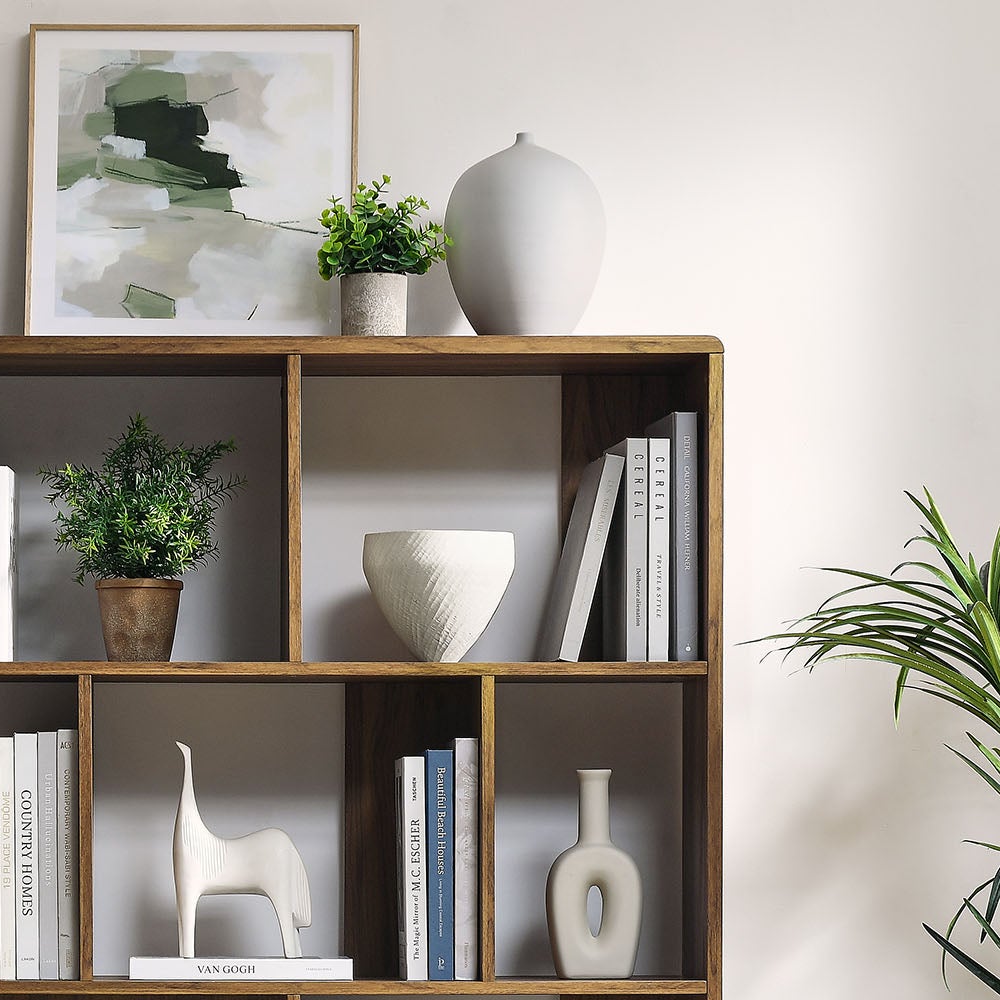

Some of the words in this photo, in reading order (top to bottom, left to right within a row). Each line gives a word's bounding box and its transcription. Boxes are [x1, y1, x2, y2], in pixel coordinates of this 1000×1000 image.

[634, 454, 643, 519] CEREAL
[655, 457, 664, 521] CEREAL
[45, 774, 53, 804] Urban
[437, 767, 446, 809] Beautiful
[21, 790, 32, 859] COUNTRY
[437, 811, 446, 838] Beach
[45, 808, 53, 887] Hallucinations
[410, 819, 420, 863] ESCHER
[3, 844, 11, 874] PLACE
[437, 841, 446, 875] Houses
[3, 878, 11, 888] 19
[22, 864, 33, 916] HOMES
[411, 867, 421, 891] M.C.
[412, 894, 418, 902] of
[413, 927, 421, 946] Magic
[197, 965, 220, 974] VAN
[223, 965, 255, 974] GOGH
